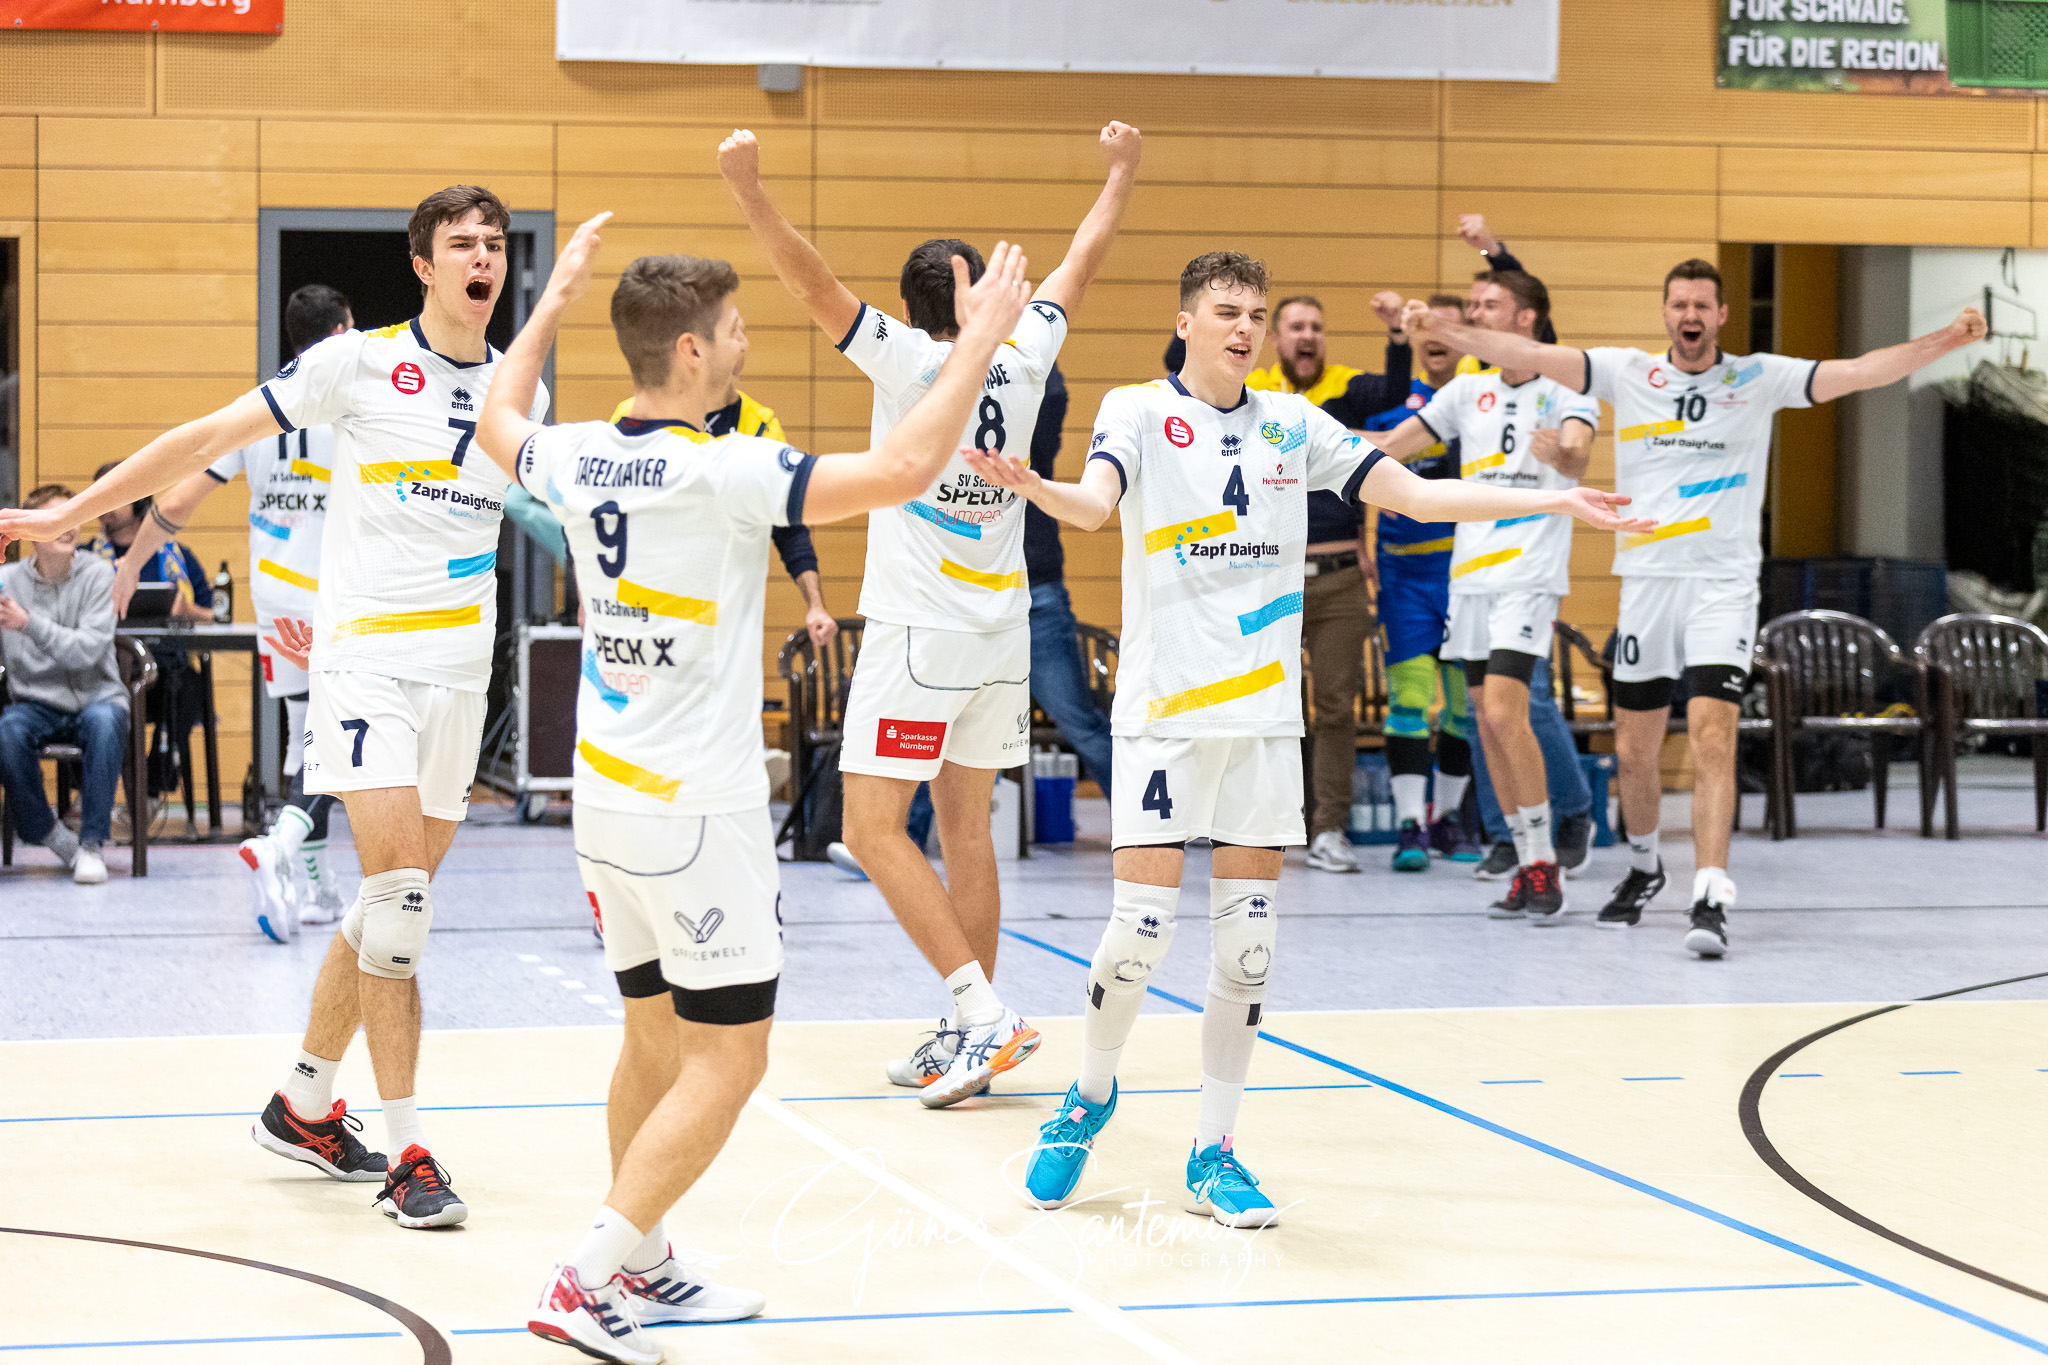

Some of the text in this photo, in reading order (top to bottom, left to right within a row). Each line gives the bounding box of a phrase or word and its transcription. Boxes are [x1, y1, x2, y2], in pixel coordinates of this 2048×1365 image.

[1728, 30, 1946, 71] FÜR DIE REGION.
[451, 400, 474, 412] errea
[1673, 393, 1707, 422] 10
[975, 395, 1006, 457] 8
[1501, 423, 1516, 455] 6
[448, 417, 476, 467] 7
[958, 474, 972, 487] SV
[1222, 465, 1250, 516] 4
[411, 482, 502, 512] Zapf Daigfuss
[590, 500, 628, 579] 9
[1190, 541, 1280, 560] Zapf Daigfuss
[340, 717, 370, 768] 7
[899, 742, 935, 753] Nürnberg
[900, 732, 938, 743] Sparkasse
[1142, 769, 1173, 820] 4
[402, 903, 423, 913] errea
[1249, 910, 1268, 918] errea
[1136, 927, 1159, 939] errea
